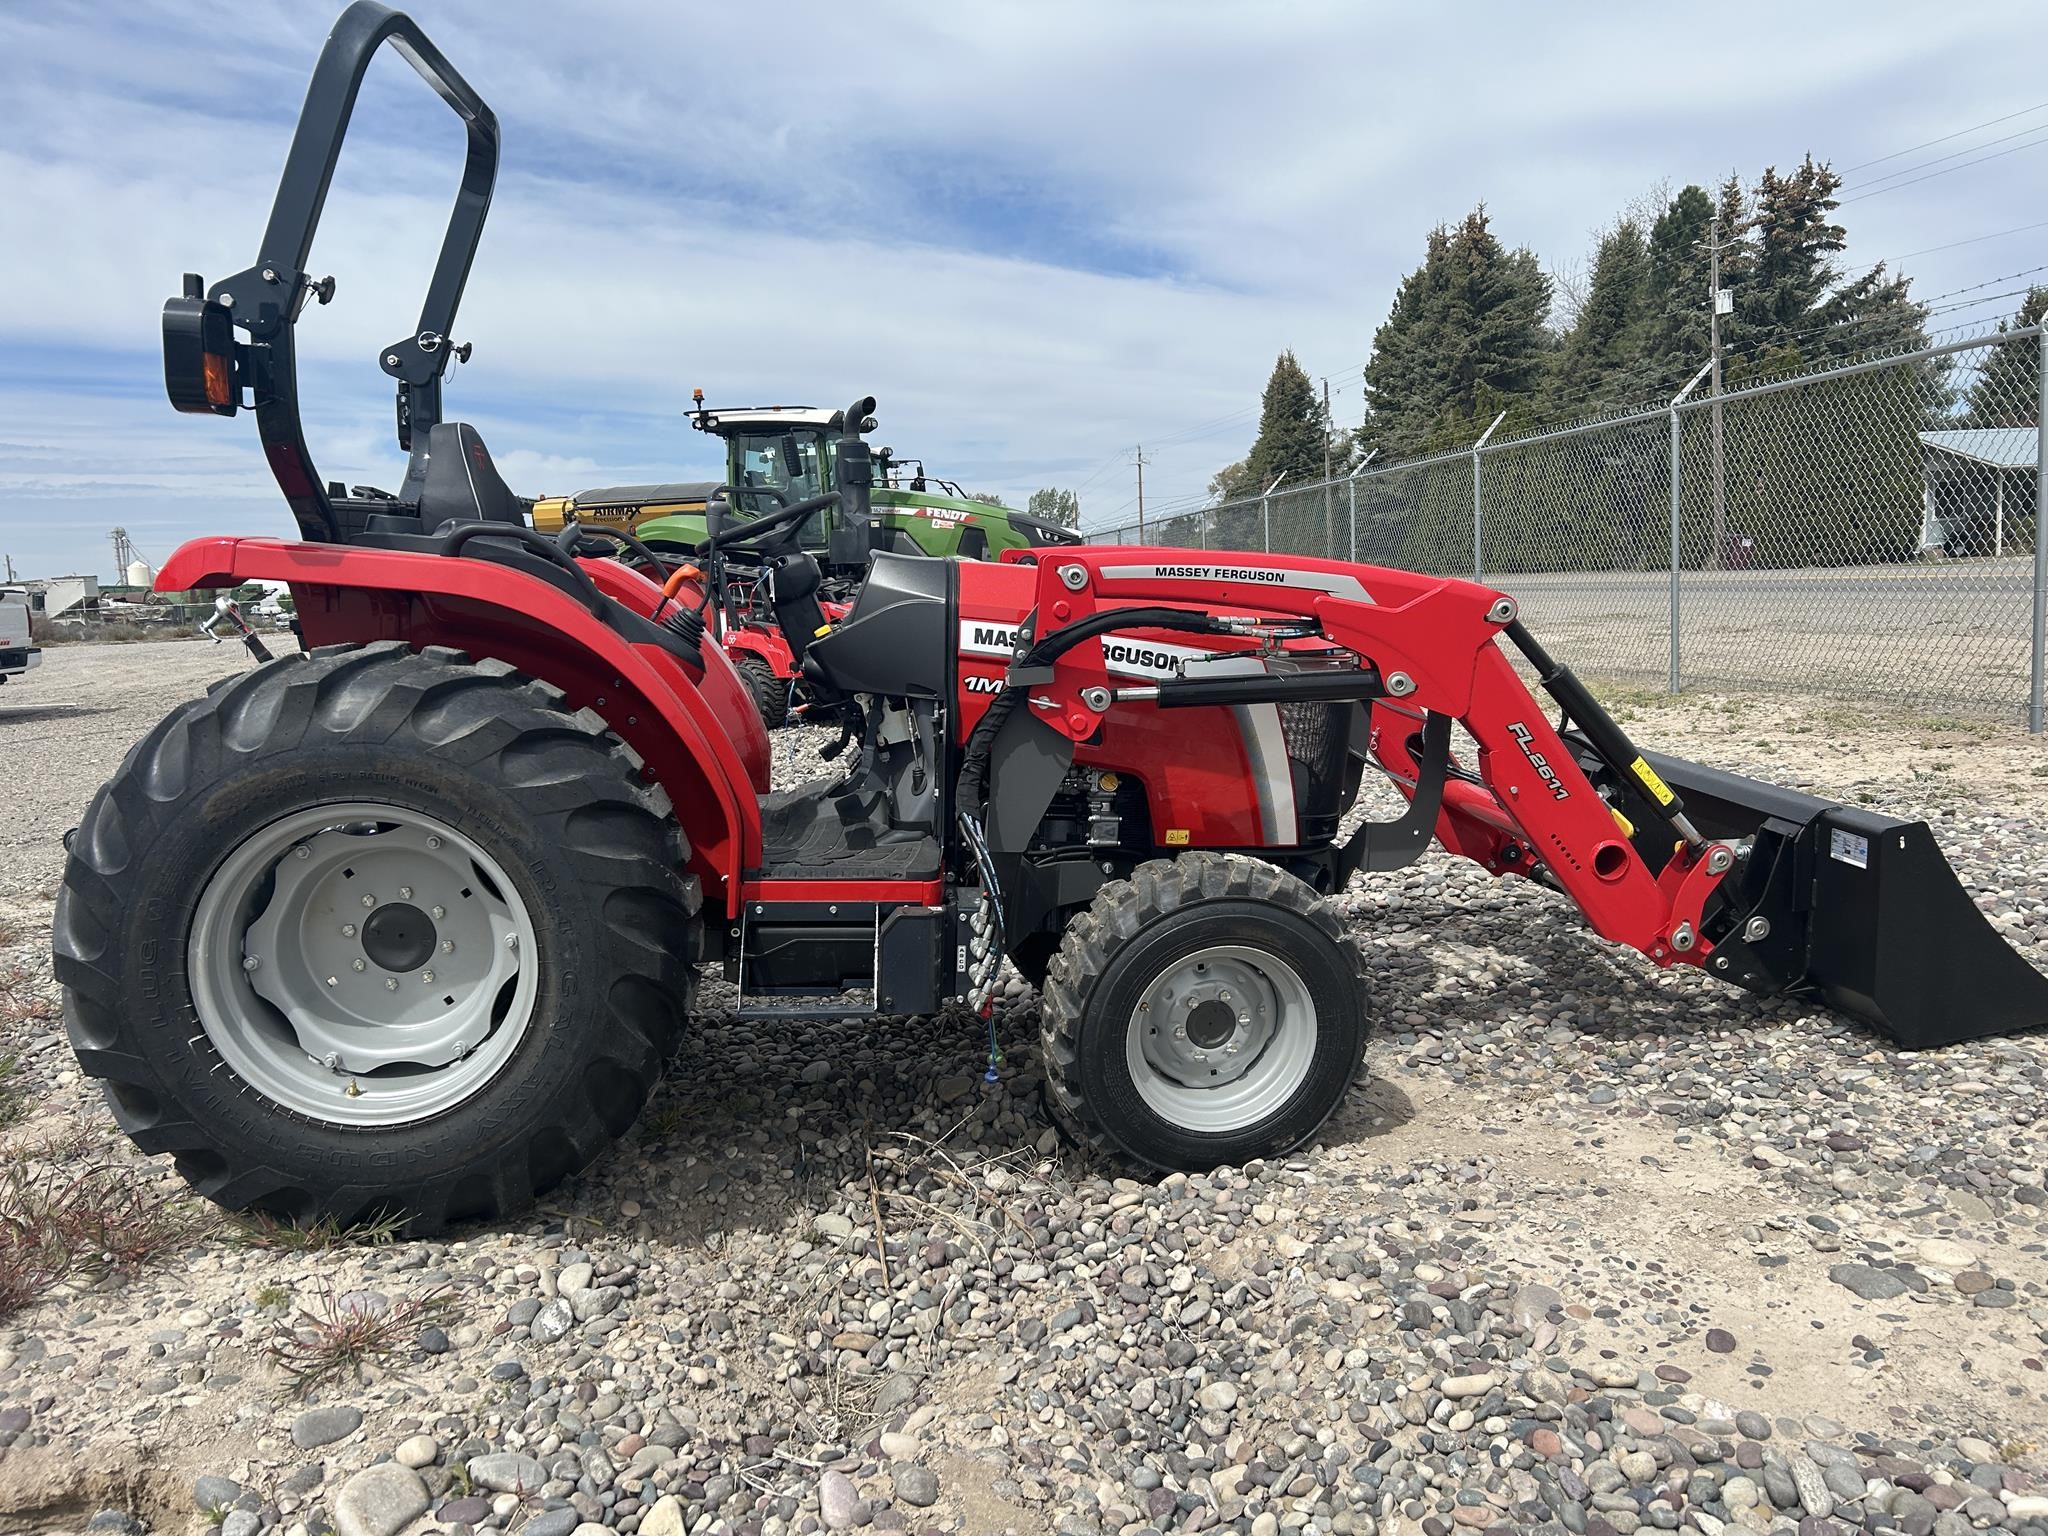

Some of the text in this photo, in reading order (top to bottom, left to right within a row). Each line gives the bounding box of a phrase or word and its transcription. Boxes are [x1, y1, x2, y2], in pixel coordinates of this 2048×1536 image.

[593, 504, 641, 520] AIRMAX
[926, 507, 970, 520] FENDT
[1155, 567, 1285, 582] MASSEY FERGUSON
[974, 627, 1181, 672] MAS RGUSON
[1506, 721, 1571, 801] FL.2611
